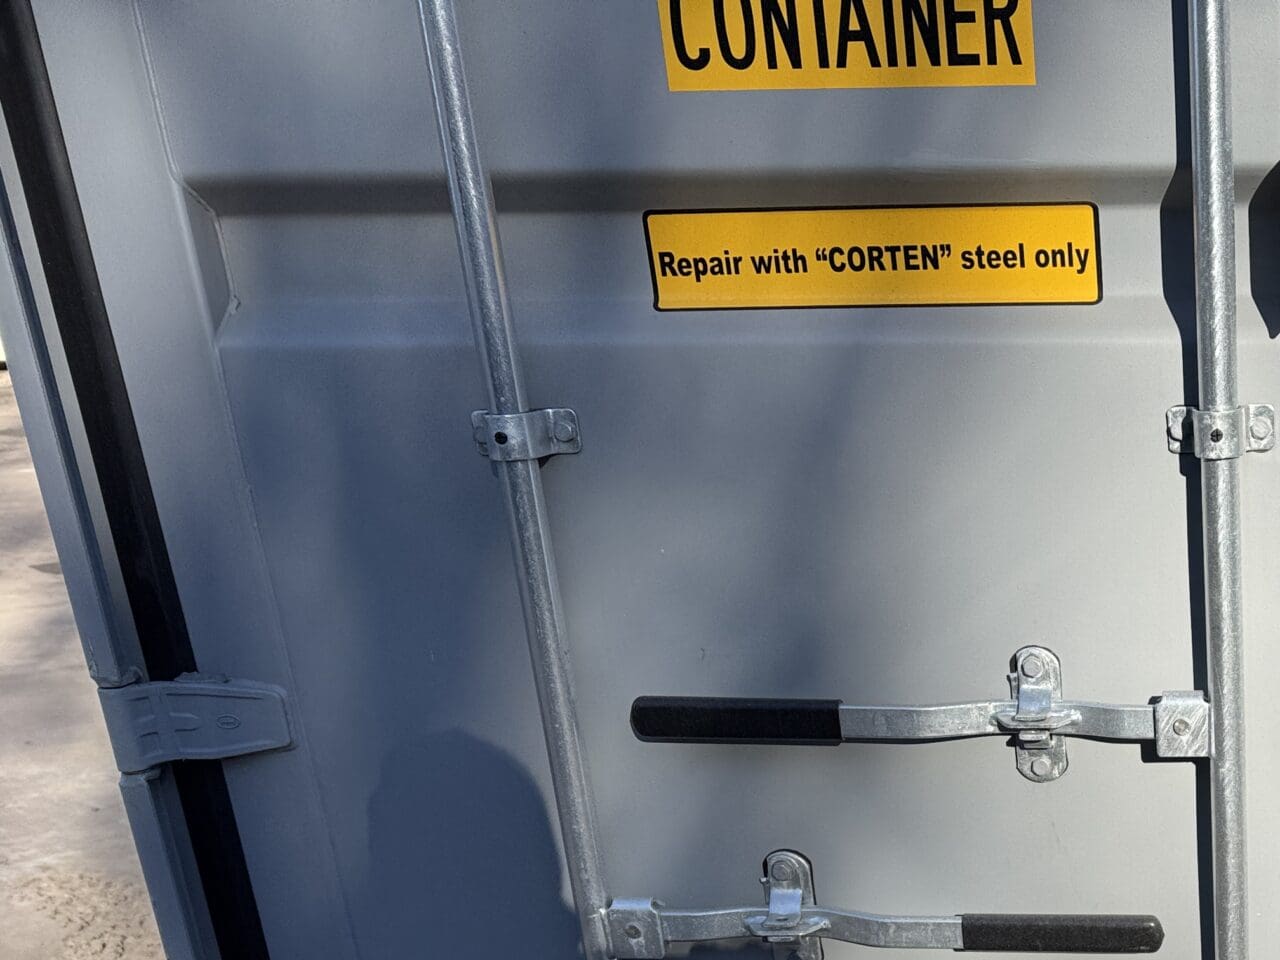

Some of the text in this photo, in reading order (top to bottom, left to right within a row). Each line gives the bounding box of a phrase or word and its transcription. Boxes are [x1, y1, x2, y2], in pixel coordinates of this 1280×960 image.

[669, 0, 1024, 71] CONTAINER
[657, 241, 1091, 283] Repair with “CORTEN” steel only
